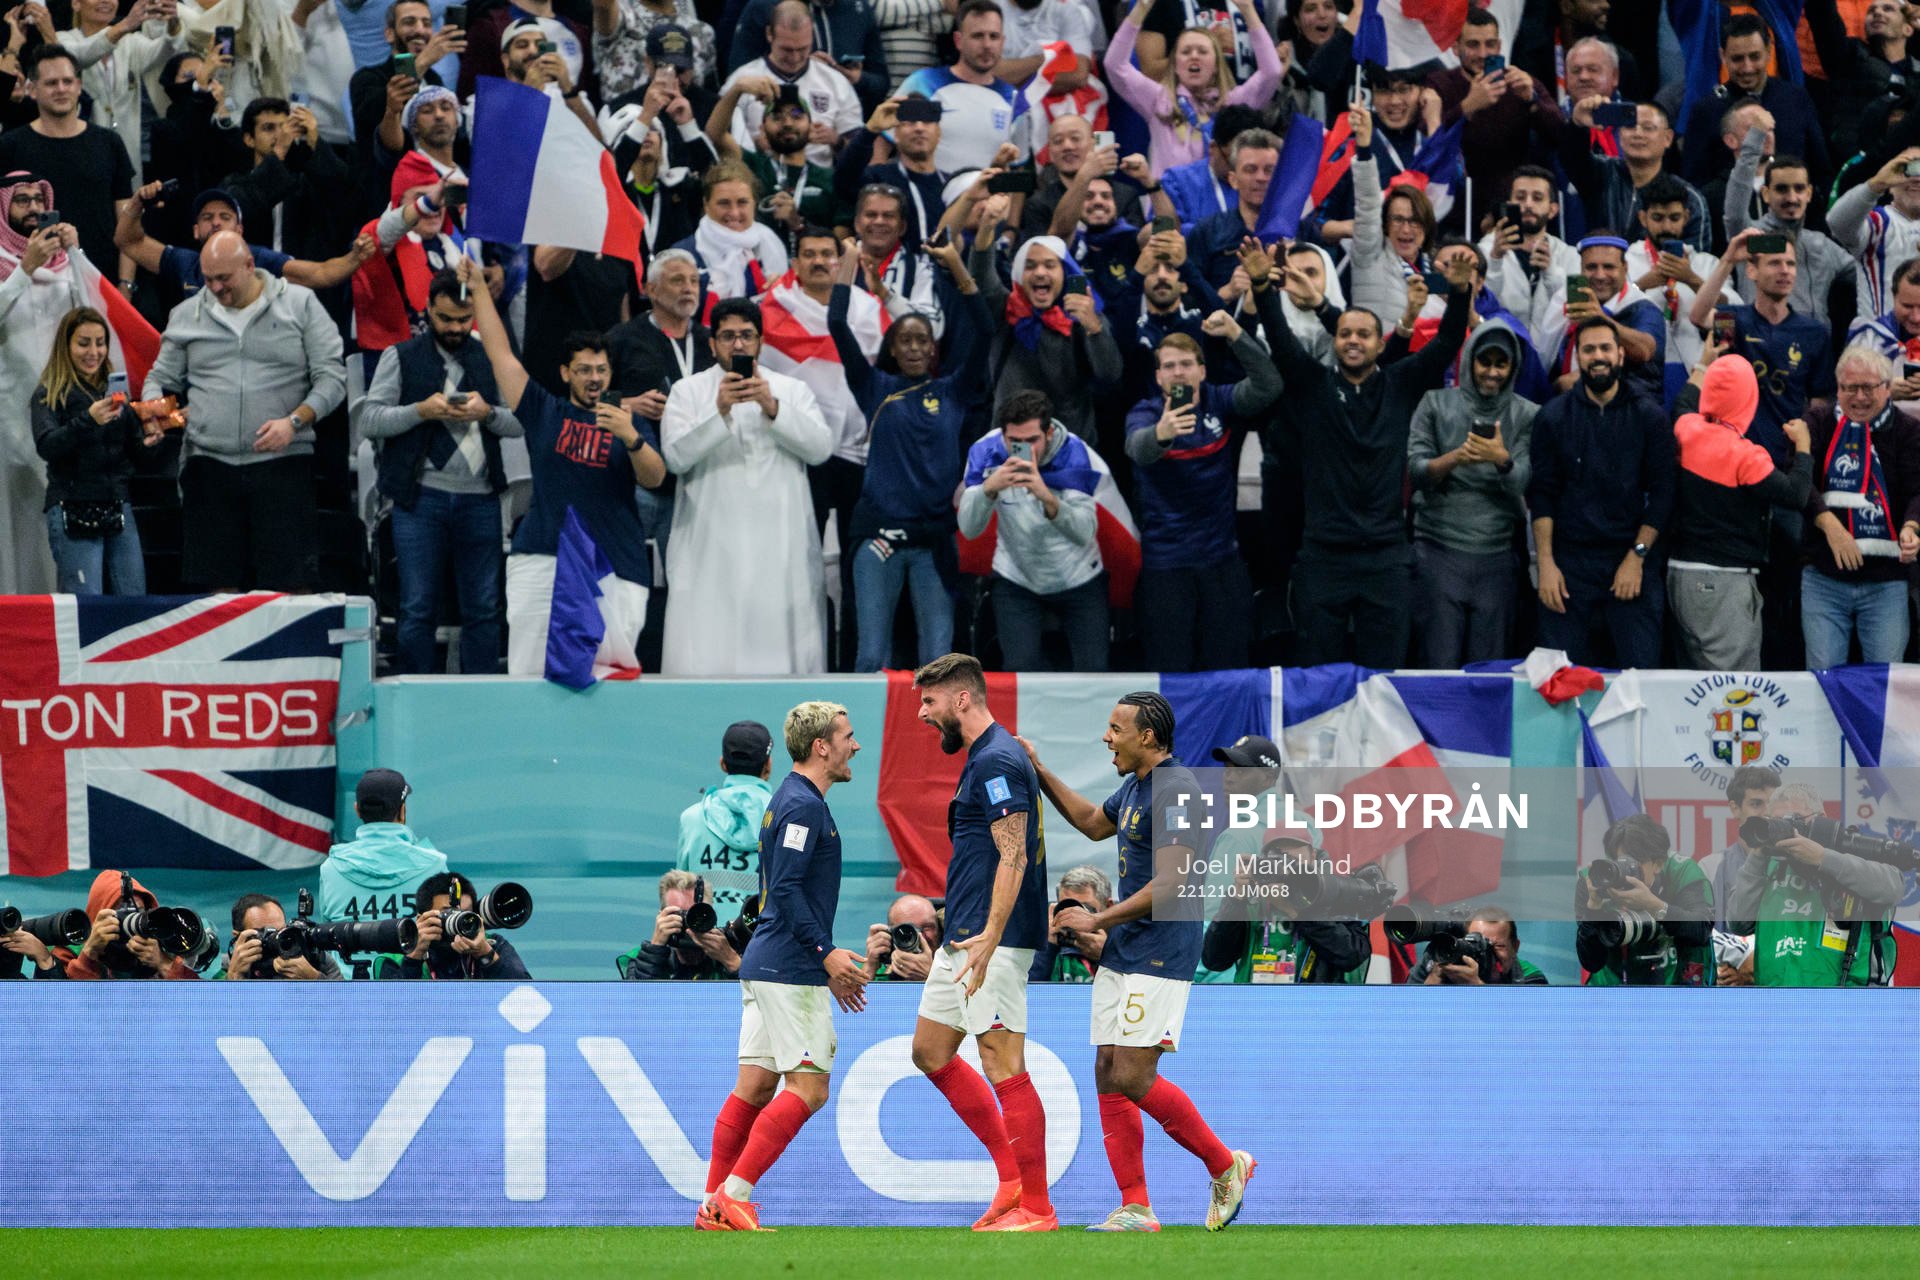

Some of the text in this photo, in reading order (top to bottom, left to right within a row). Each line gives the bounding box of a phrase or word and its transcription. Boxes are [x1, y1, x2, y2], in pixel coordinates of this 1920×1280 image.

[1684, 674, 1790, 708] LUTON TOWN
[2, 689, 319, 746] TON REDS
[1684, 752, 1791, 790] FOOTB UB
[700, 844, 760, 874] 443
[1118, 847, 1129, 878] 5
[344, 893, 417, 920] 4445
[1780, 898, 1813, 916] 94
[1123, 993, 1146, 1024] 5
